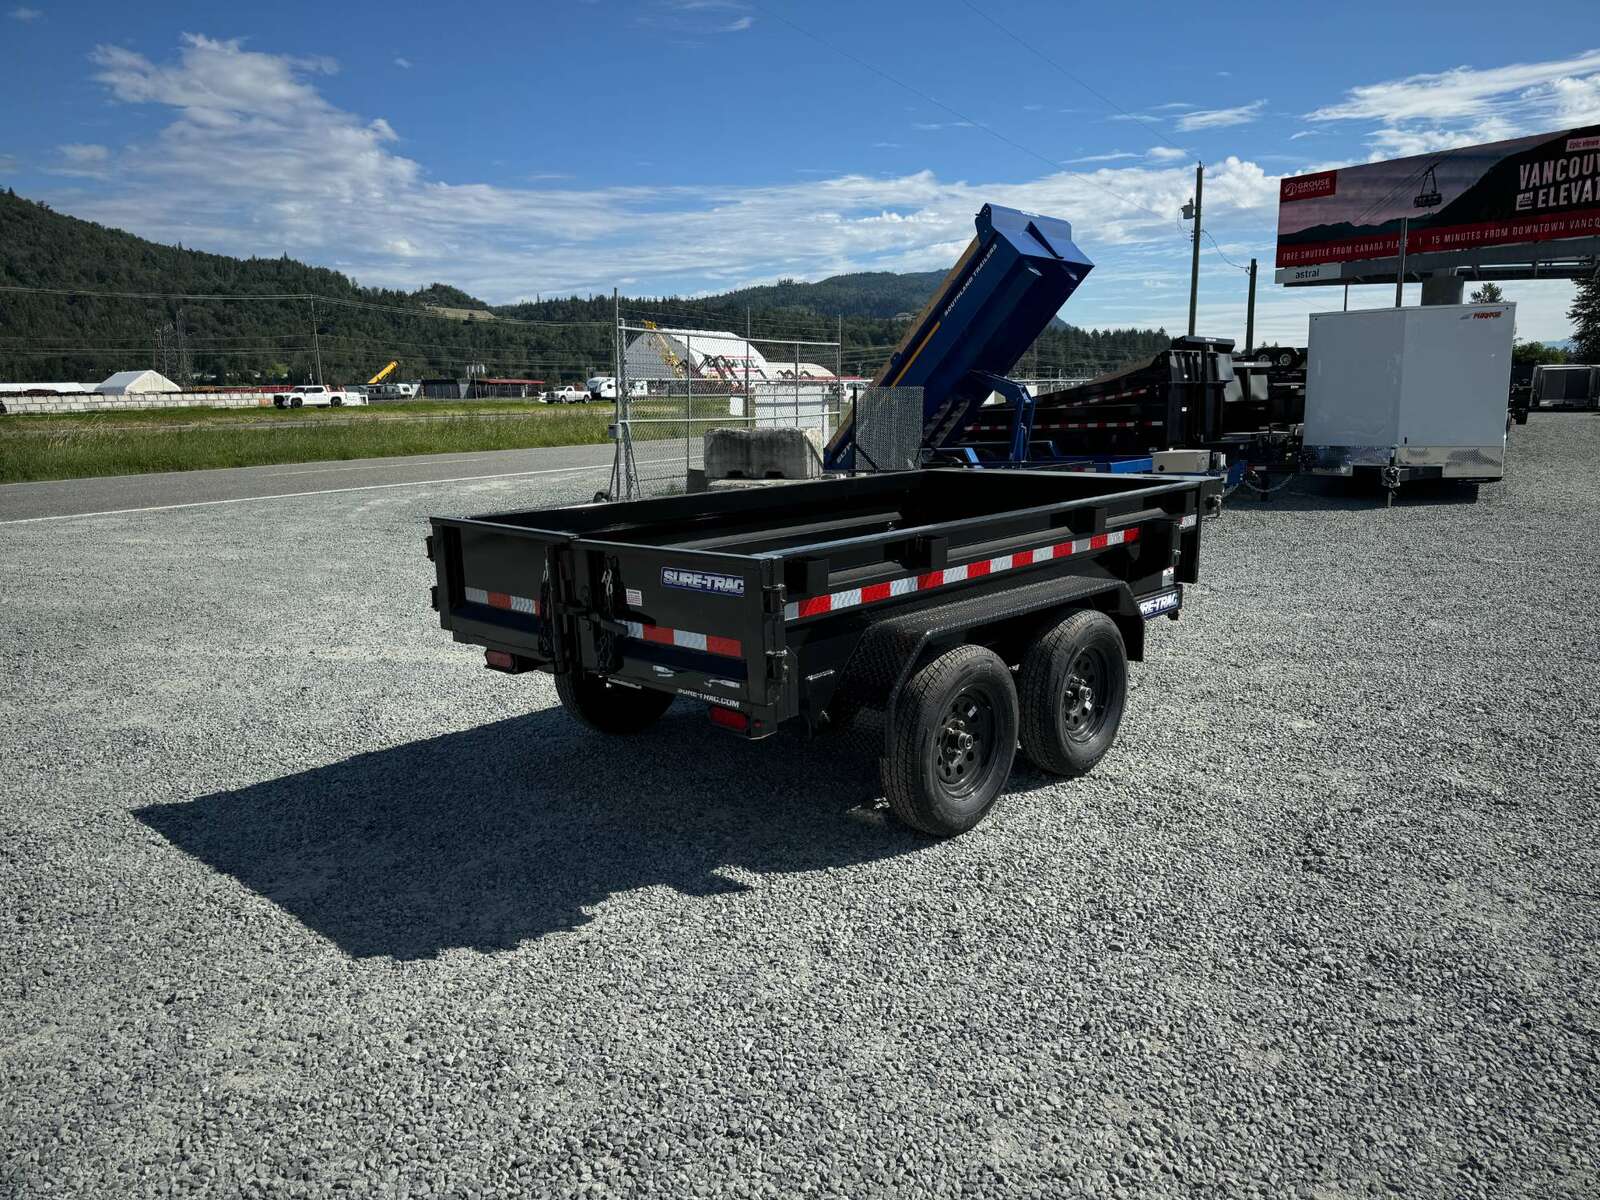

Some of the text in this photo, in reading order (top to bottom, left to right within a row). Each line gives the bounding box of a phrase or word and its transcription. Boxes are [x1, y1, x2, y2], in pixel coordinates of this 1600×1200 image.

[1298, 178, 1330, 190] GROUSE
[1283, 250, 1298, 261] FREE
[1301, 247, 1330, 259] SHUTTLE
[1332, 245, 1352, 256] FROM
[1355, 241, 1384, 253] CANADA
[1386, 238, 1409, 249] PLAE
[1431, 235, 1440, 244] 15
[1444, 230, 1481, 243] MINUTES
[1485, 227, 1508, 239] FROM
[1513, 221, 1565, 235] DOWNTOWN
[944, 243, 997, 317] SOUTHLAND TRAILERS
[1295, 268, 1320, 280] astral
[663, 570, 745, 594] SURE-TRAC
